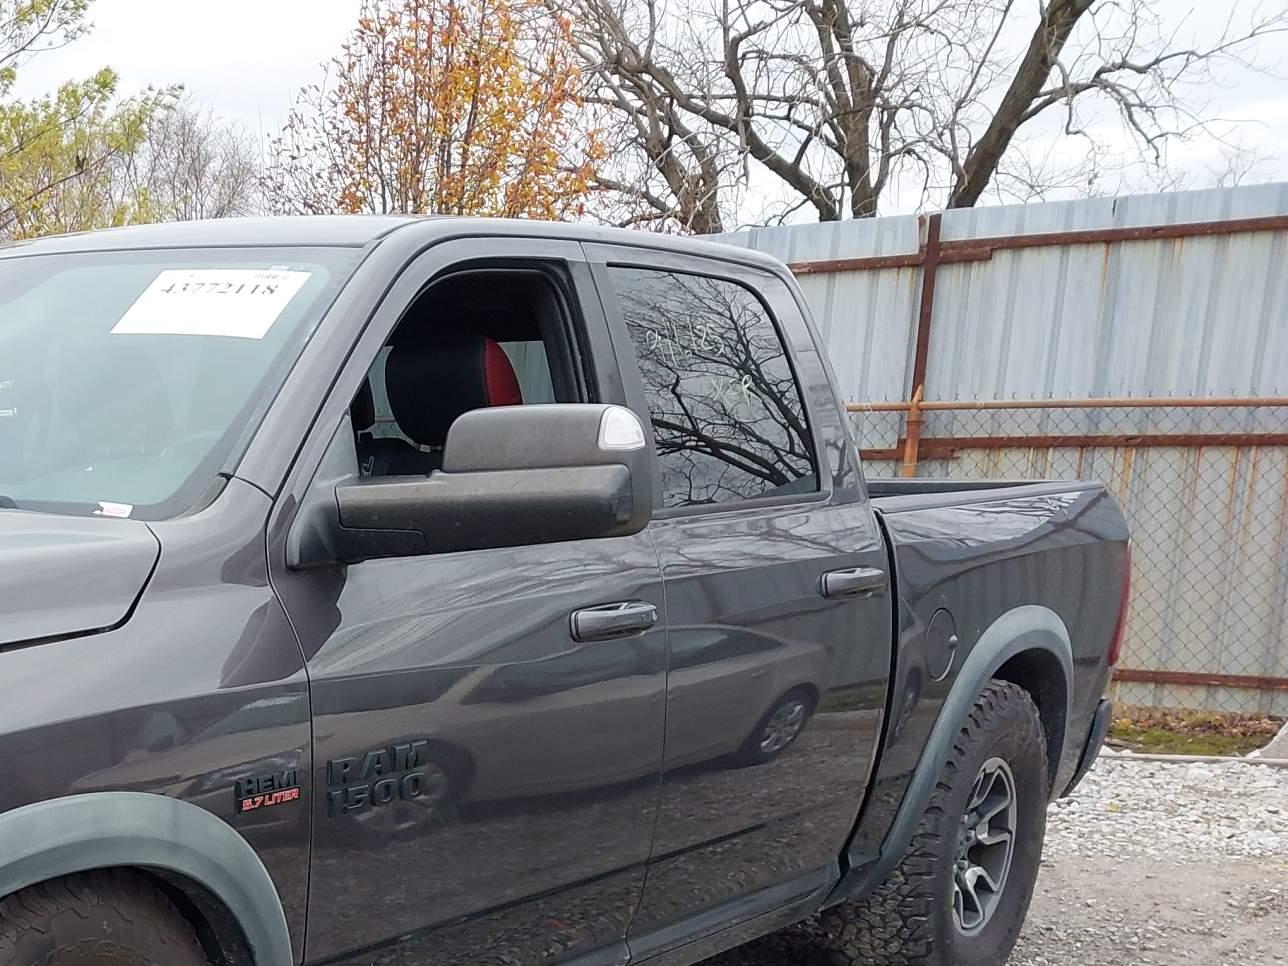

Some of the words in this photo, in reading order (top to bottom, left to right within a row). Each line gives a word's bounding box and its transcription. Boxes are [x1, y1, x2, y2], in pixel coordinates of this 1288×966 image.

[161, 282, 279, 295] 43772118
[327, 739, 430, 786] RAM
[234, 769, 297, 798] HEMI
[327, 772, 429, 817] 1500
[242, 795, 264, 811] 5.7
[264, 787, 299, 806] LITER
